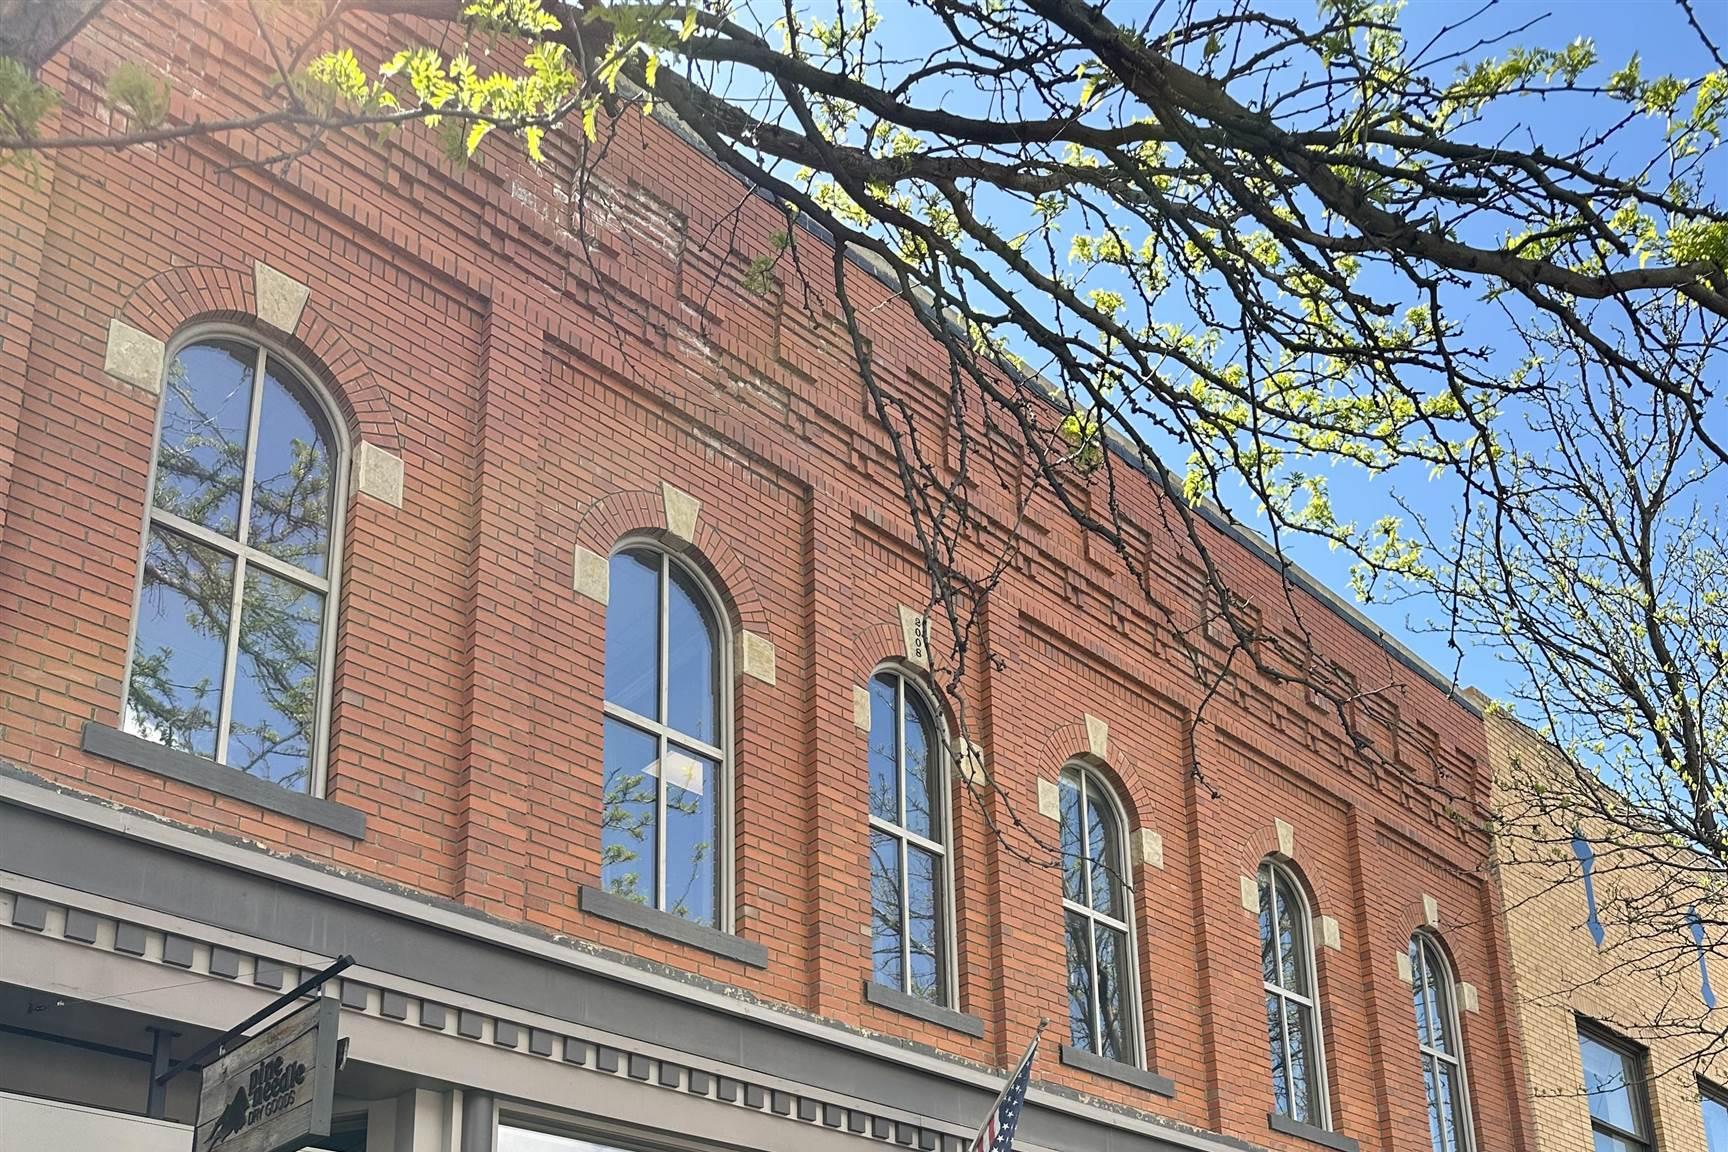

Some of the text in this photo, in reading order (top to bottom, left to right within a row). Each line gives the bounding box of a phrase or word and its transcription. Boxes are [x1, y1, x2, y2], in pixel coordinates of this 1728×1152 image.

[248, 1056, 283, 1097] pine
[252, 1061, 306, 1107] needle
[247, 1089, 296, 1126] DRY GOODS
